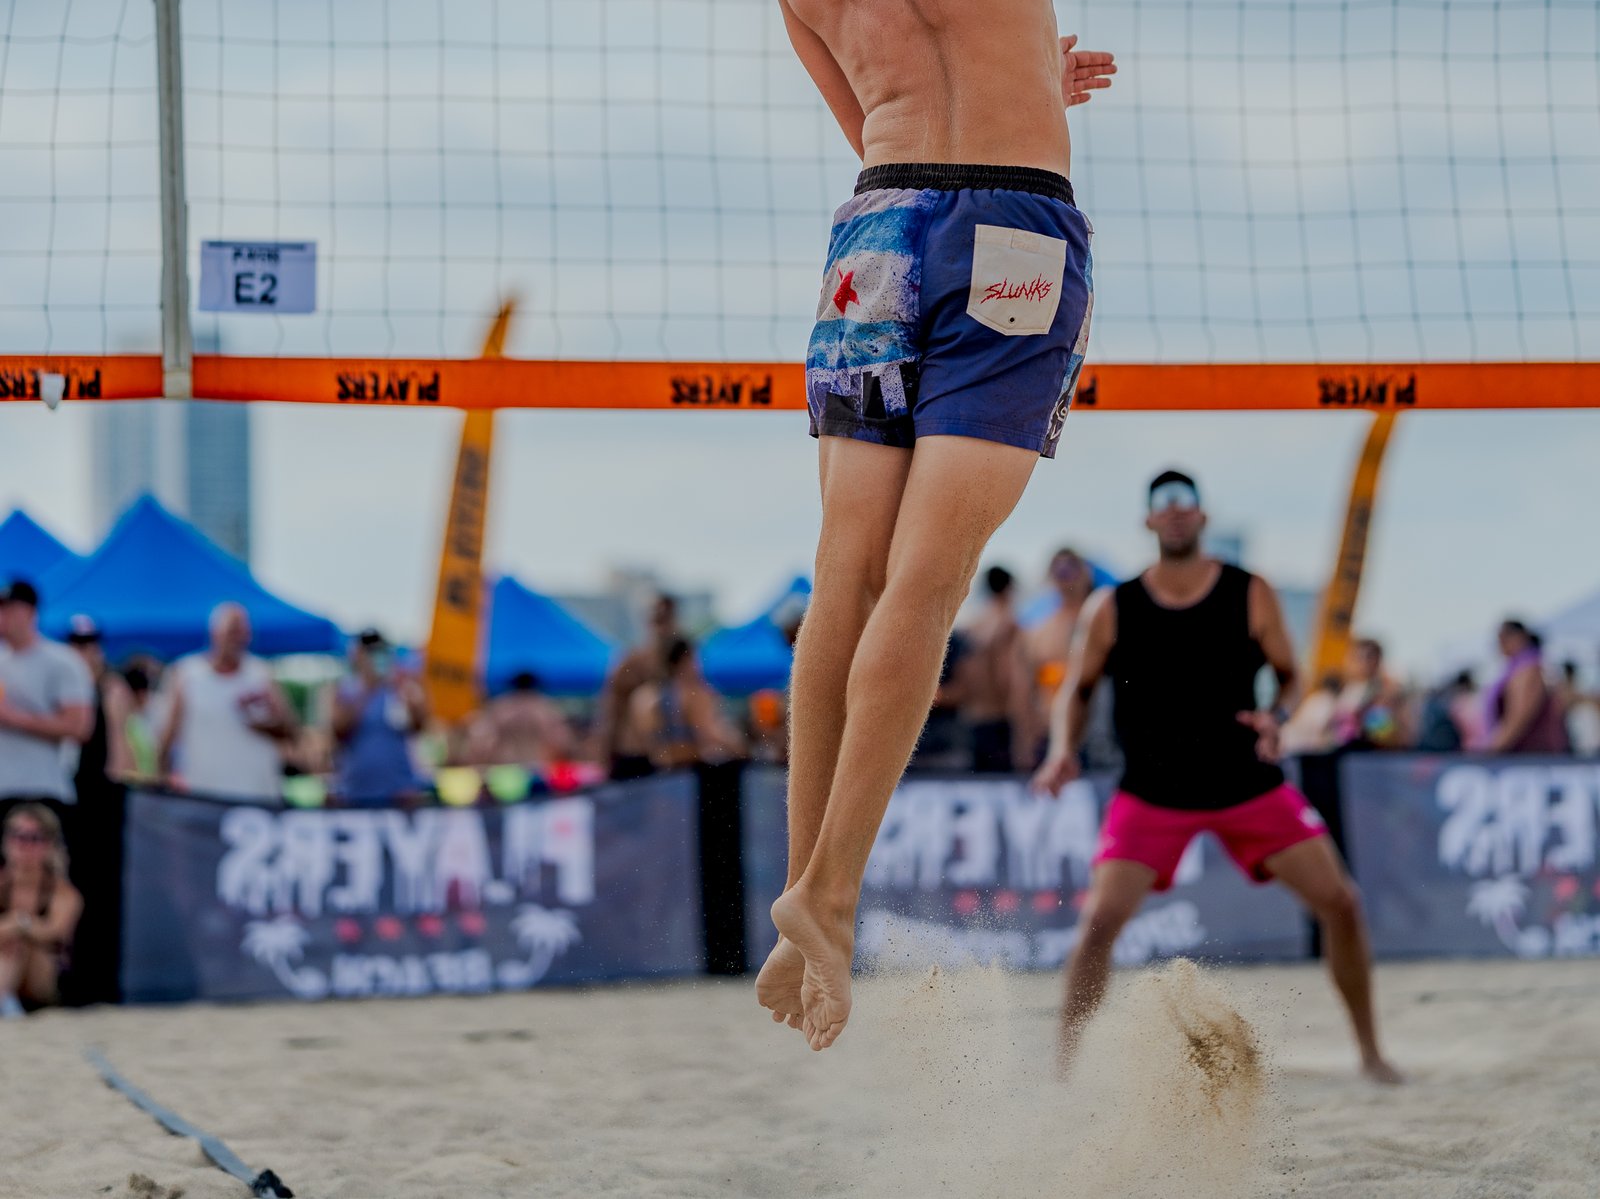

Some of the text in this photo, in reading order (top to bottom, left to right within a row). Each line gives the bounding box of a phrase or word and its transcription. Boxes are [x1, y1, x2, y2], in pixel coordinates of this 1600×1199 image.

[234, 272, 278, 304] E2
[980, 273, 1054, 304] SLUNKS
[337, 370, 440, 401] PLAYERS
[671, 375, 772, 404] PLAYERS
[1319, 373, 1416, 404] PLAYERS
